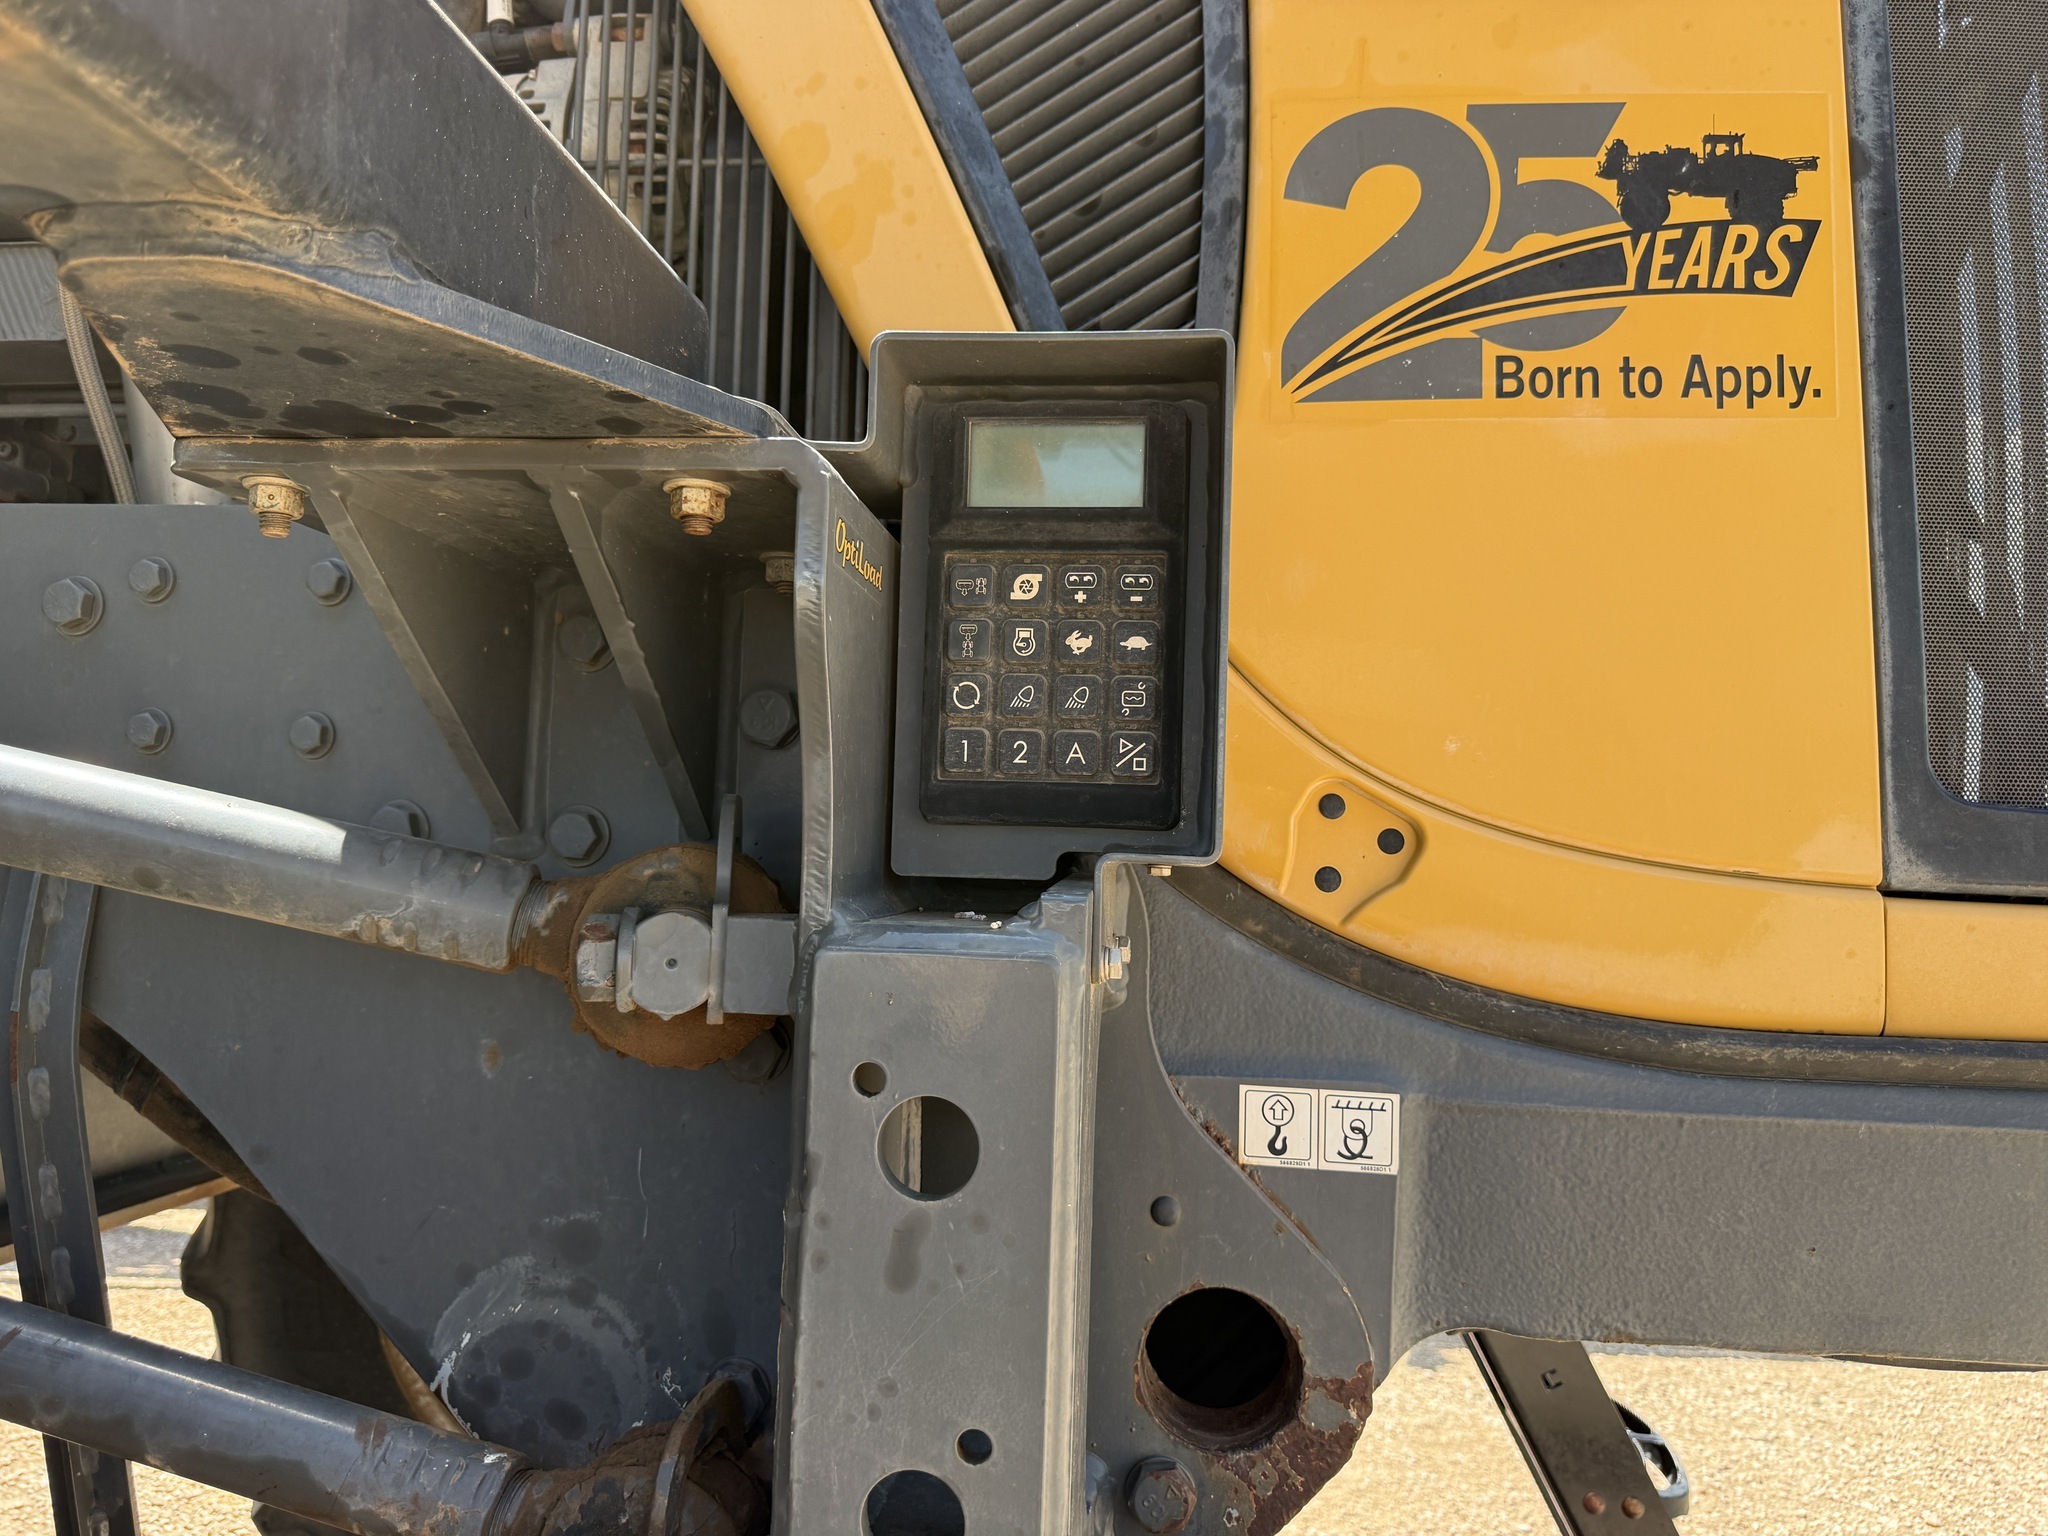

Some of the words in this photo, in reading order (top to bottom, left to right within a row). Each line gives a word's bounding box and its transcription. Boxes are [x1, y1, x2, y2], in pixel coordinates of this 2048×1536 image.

[1281, 102, 1627, 404] 25
[1622, 224, 1806, 291] YEARS
[1495, 355, 1600, 399] Born
[1619, 356, 1663, 399] to
[1681, 354, 1822, 410] Apply.
[835, 518, 884, 592] OptiLoad
[961, 740, 968, 763] 1
[1012, 740, 1028, 764] 2
[1065, 742, 1086, 765] A
